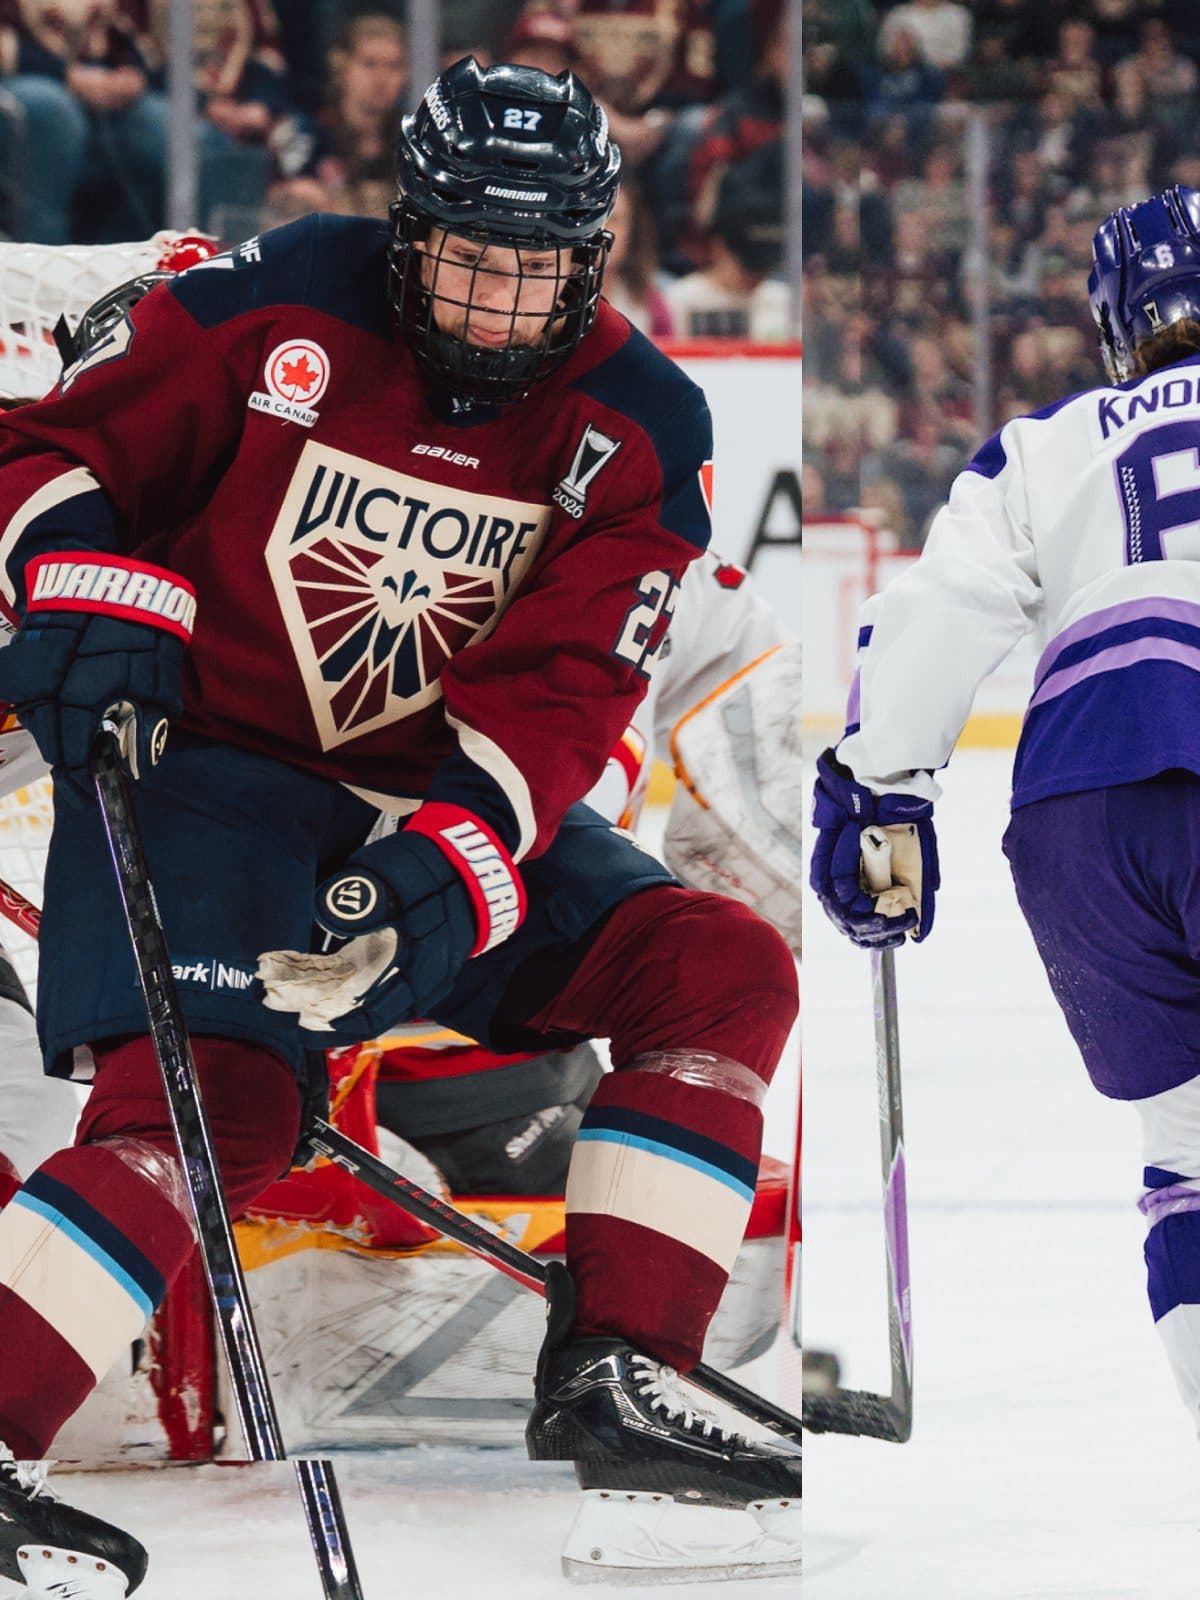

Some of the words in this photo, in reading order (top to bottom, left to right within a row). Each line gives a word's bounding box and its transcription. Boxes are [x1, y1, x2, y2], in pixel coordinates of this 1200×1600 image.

[503, 108, 543, 131] 27
[484, 185, 548, 202] WARRIOR
[1155, 244, 1175, 269] 6
[251, 396, 270, 409] AIR
[275, 403, 316, 423] CANADA
[411, 443, 480, 469] BAUER
[552, 487, 585, 520] 2026
[289, 464, 537, 597] VICTOIRE
[32, 563, 197, 635] WARRIOR
[171, 962, 210, 983] ark
